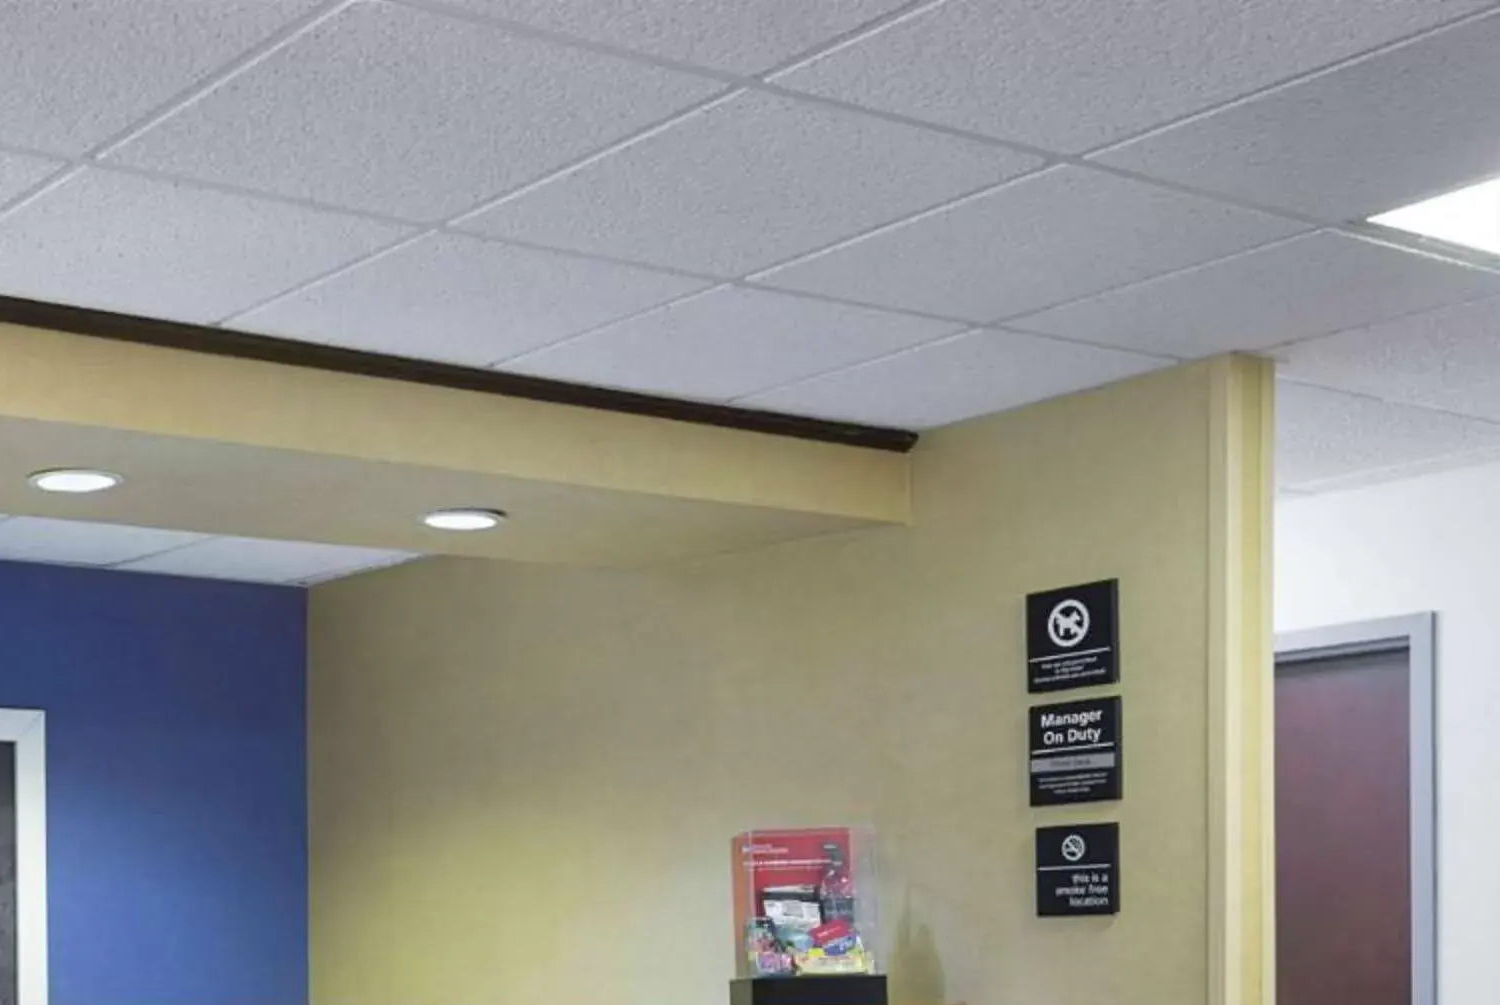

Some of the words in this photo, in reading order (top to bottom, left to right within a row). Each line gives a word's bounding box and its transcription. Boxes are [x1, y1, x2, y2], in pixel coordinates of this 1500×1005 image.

[1041, 710, 1103, 727] Manager
[1043, 731, 1064, 745] On
[1067, 728, 1102, 743] Duty
